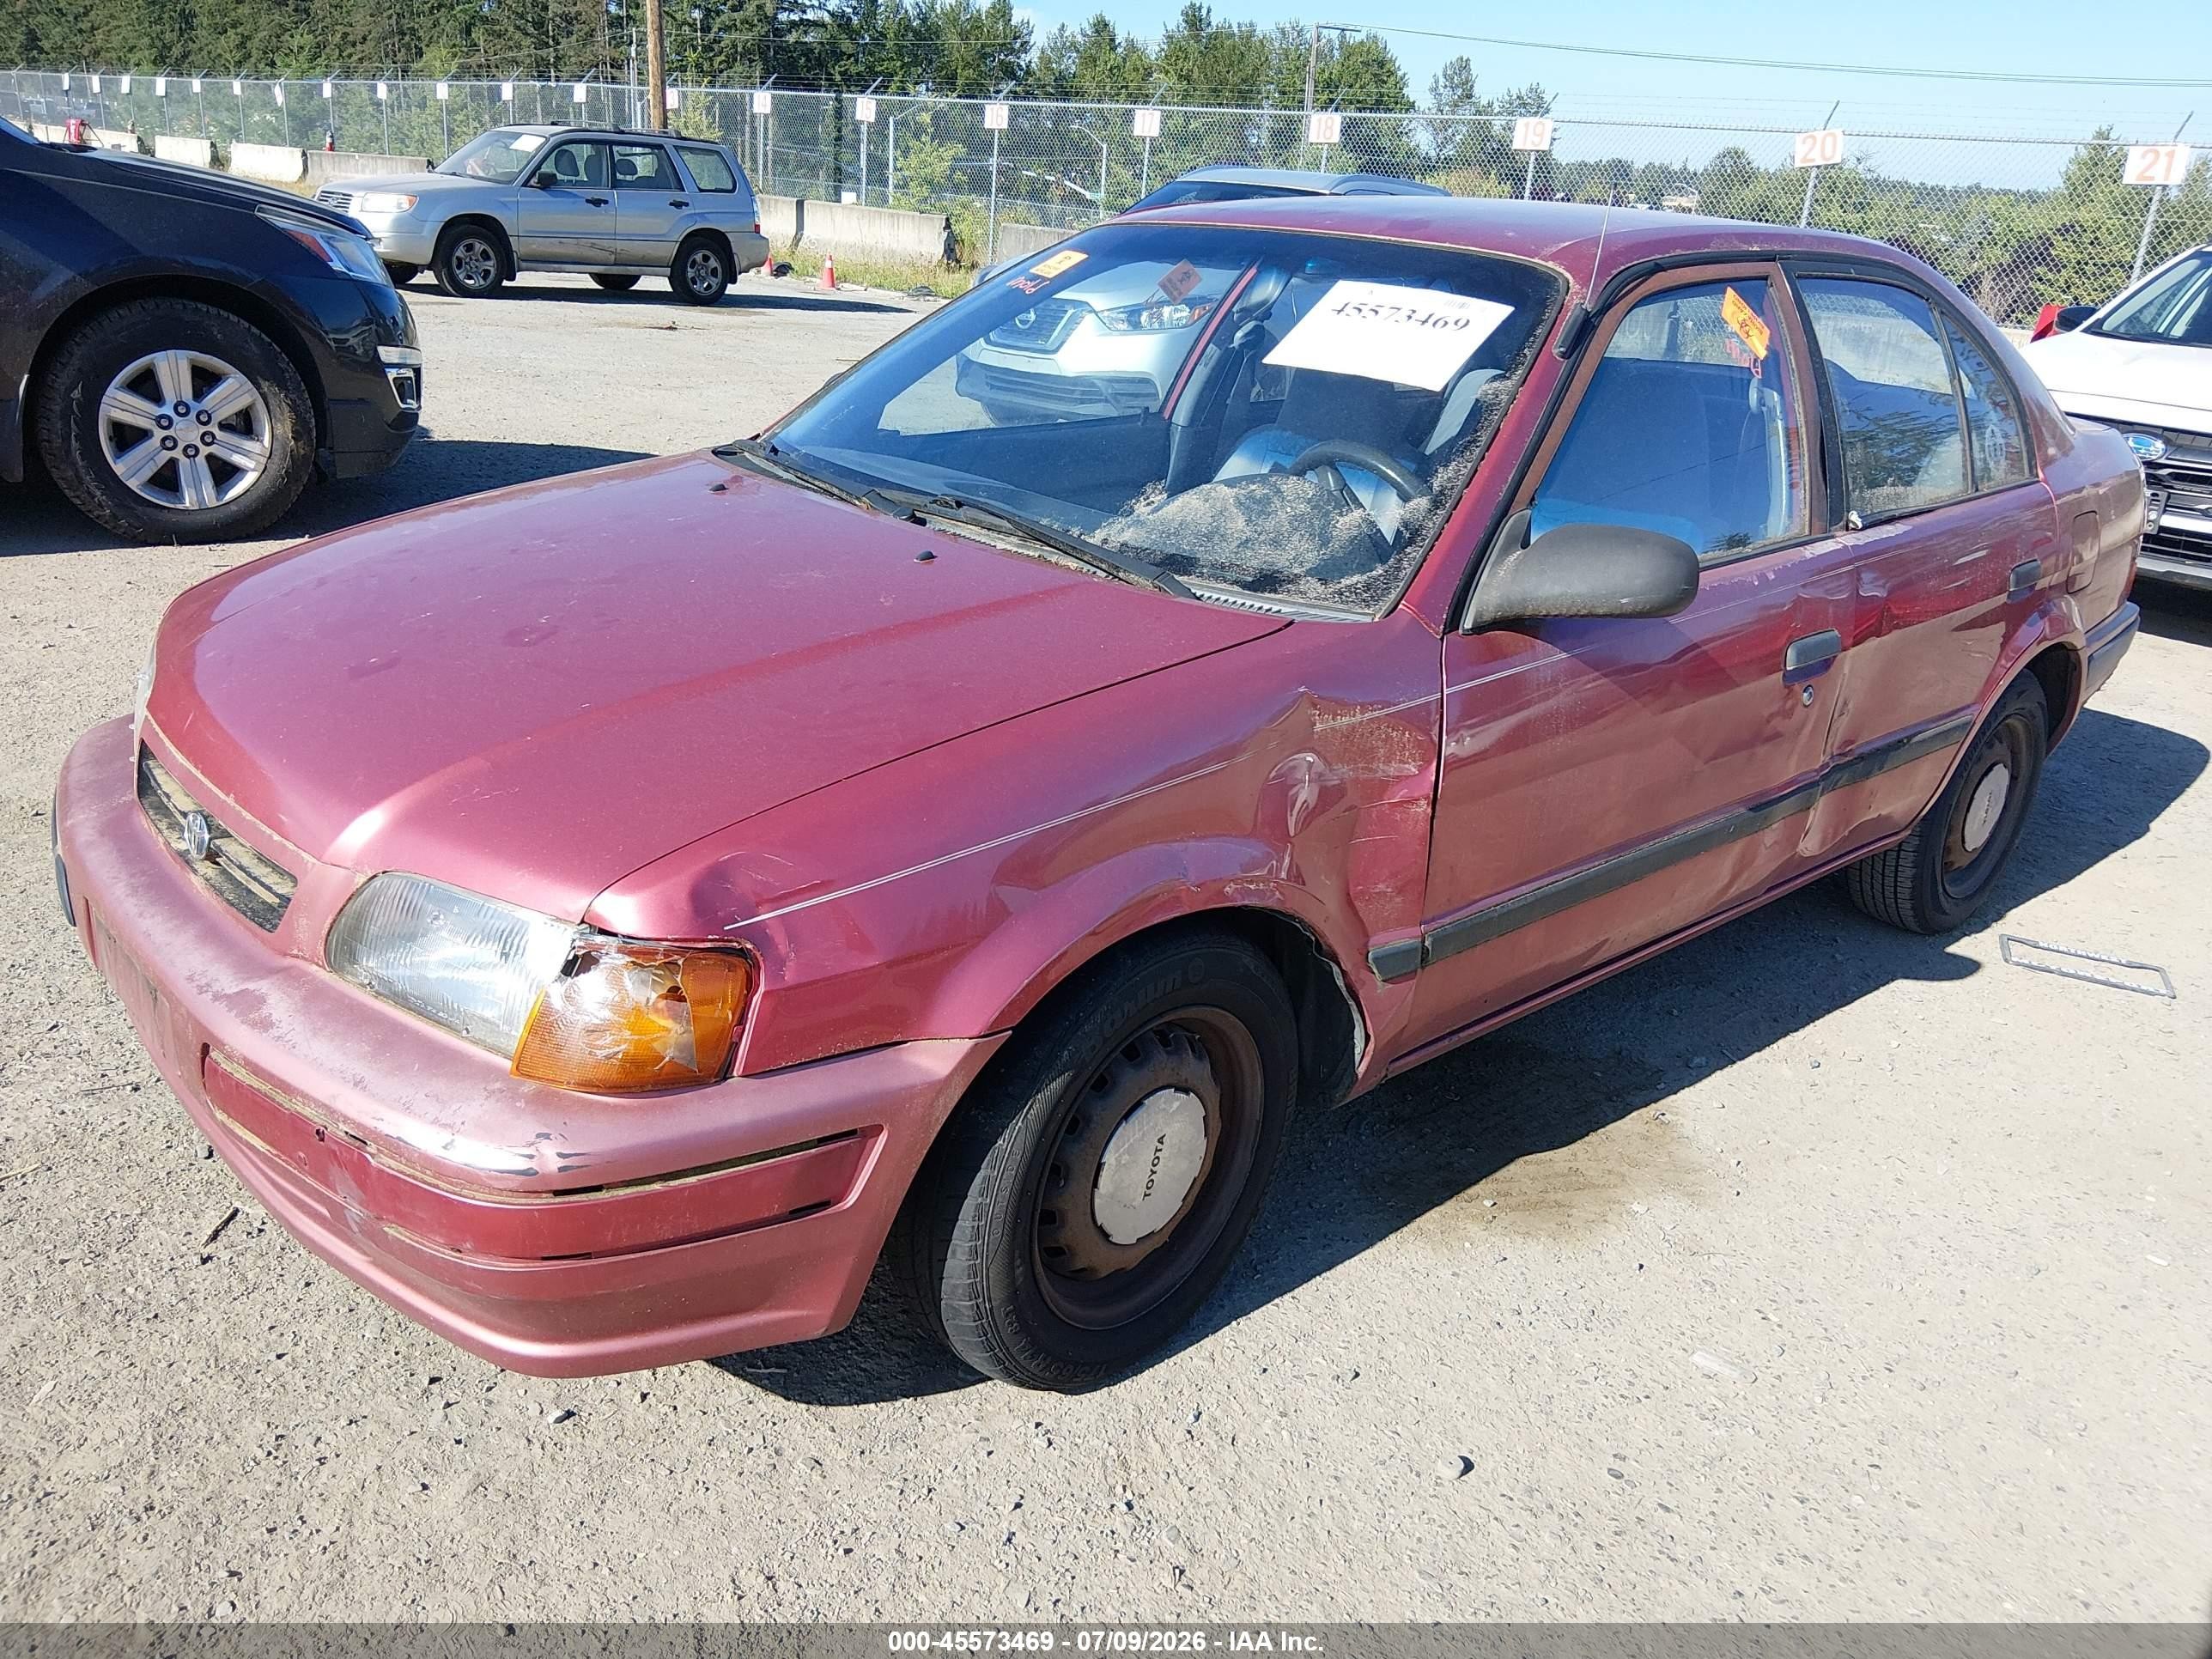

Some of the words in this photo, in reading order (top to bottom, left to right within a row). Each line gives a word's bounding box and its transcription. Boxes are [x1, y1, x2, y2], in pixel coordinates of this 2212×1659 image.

[757, 94, 767, 112] 14
[860, 100, 872, 119] 15
[989, 106, 1003, 126] 16
[1141, 112, 1155, 133] 17
[1316, 117, 1334, 140] 18
[1522, 121, 1546, 149] 19
[1800, 132, 1837, 163] 20
[2135, 148, 2176, 181] 21
[1331, 301, 1470, 331] 45573469
[1142, 1133, 1167, 1201] TOYOTA
[992, 1149, 1021, 1237] OUTSIDE
